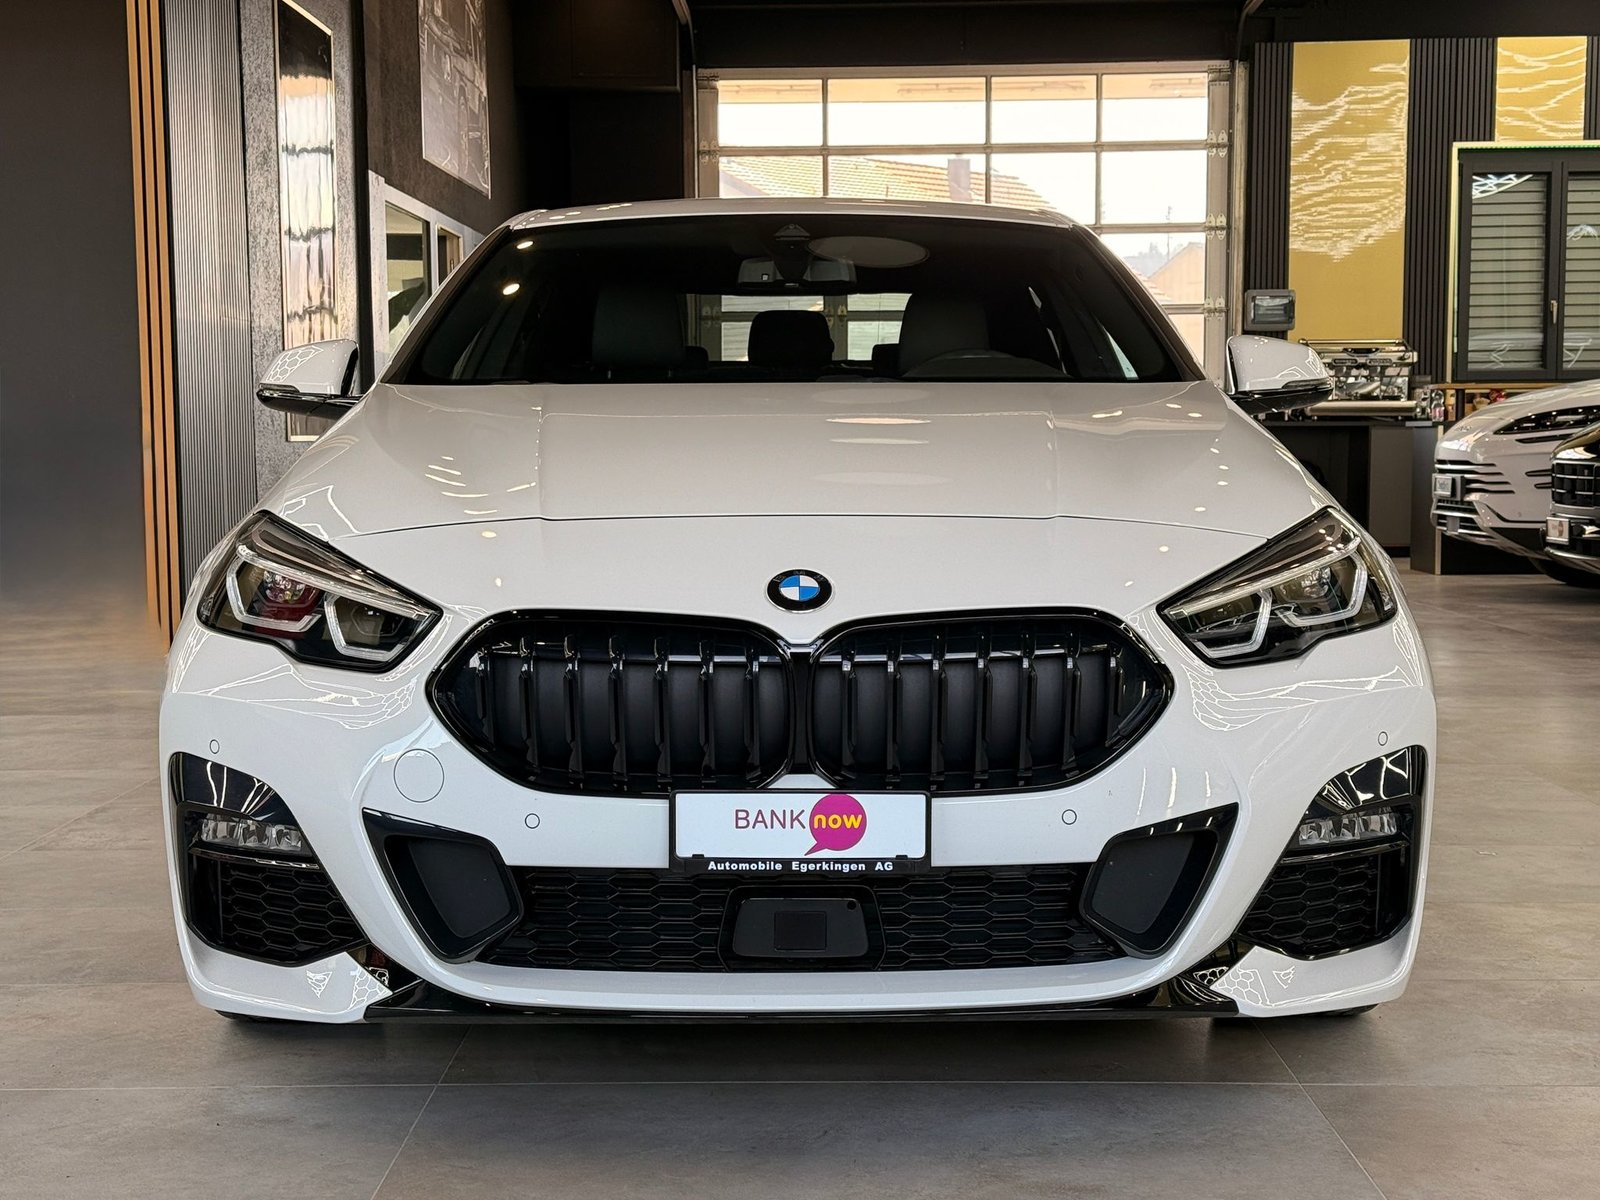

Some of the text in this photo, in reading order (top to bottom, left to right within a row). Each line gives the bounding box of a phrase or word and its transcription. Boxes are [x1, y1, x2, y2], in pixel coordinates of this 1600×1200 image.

[734, 809, 863, 829] BANK now
[707, 861, 894, 873] Automobile Egerkingen AG
